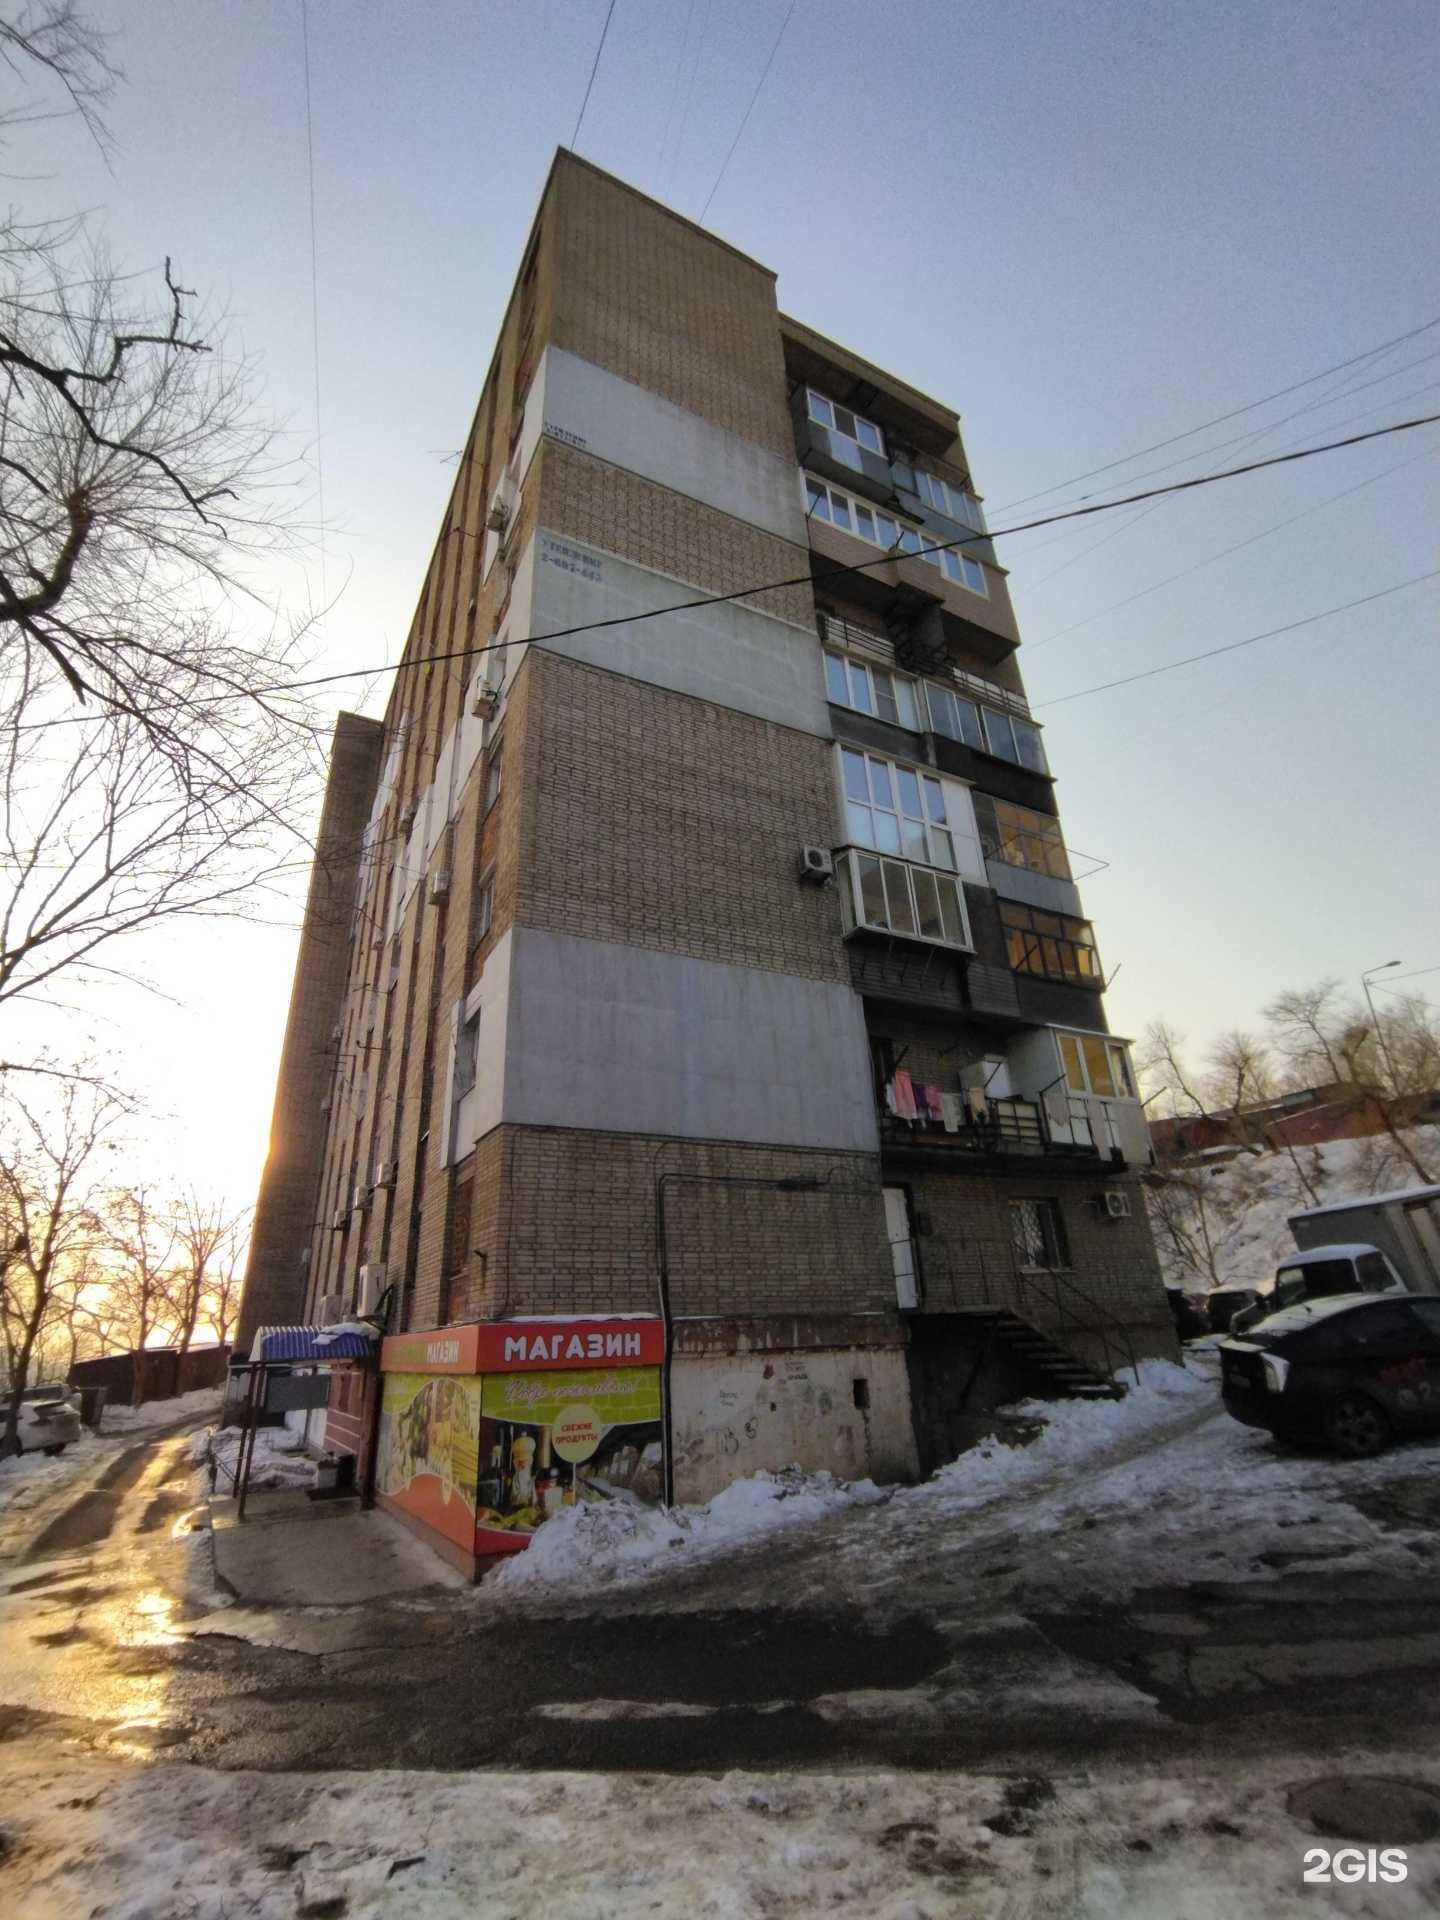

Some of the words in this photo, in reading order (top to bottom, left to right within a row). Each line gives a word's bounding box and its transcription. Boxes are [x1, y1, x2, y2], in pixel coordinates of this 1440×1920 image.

[424, 1340, 459, 1363] МАГАЗИН
[504, 1332, 641, 1362] МАГАЗИН
[561, 1421, 593, 1432] СВЕЖИЕ
[555, 1432, 598, 1445] ПРОДУКТЫ
